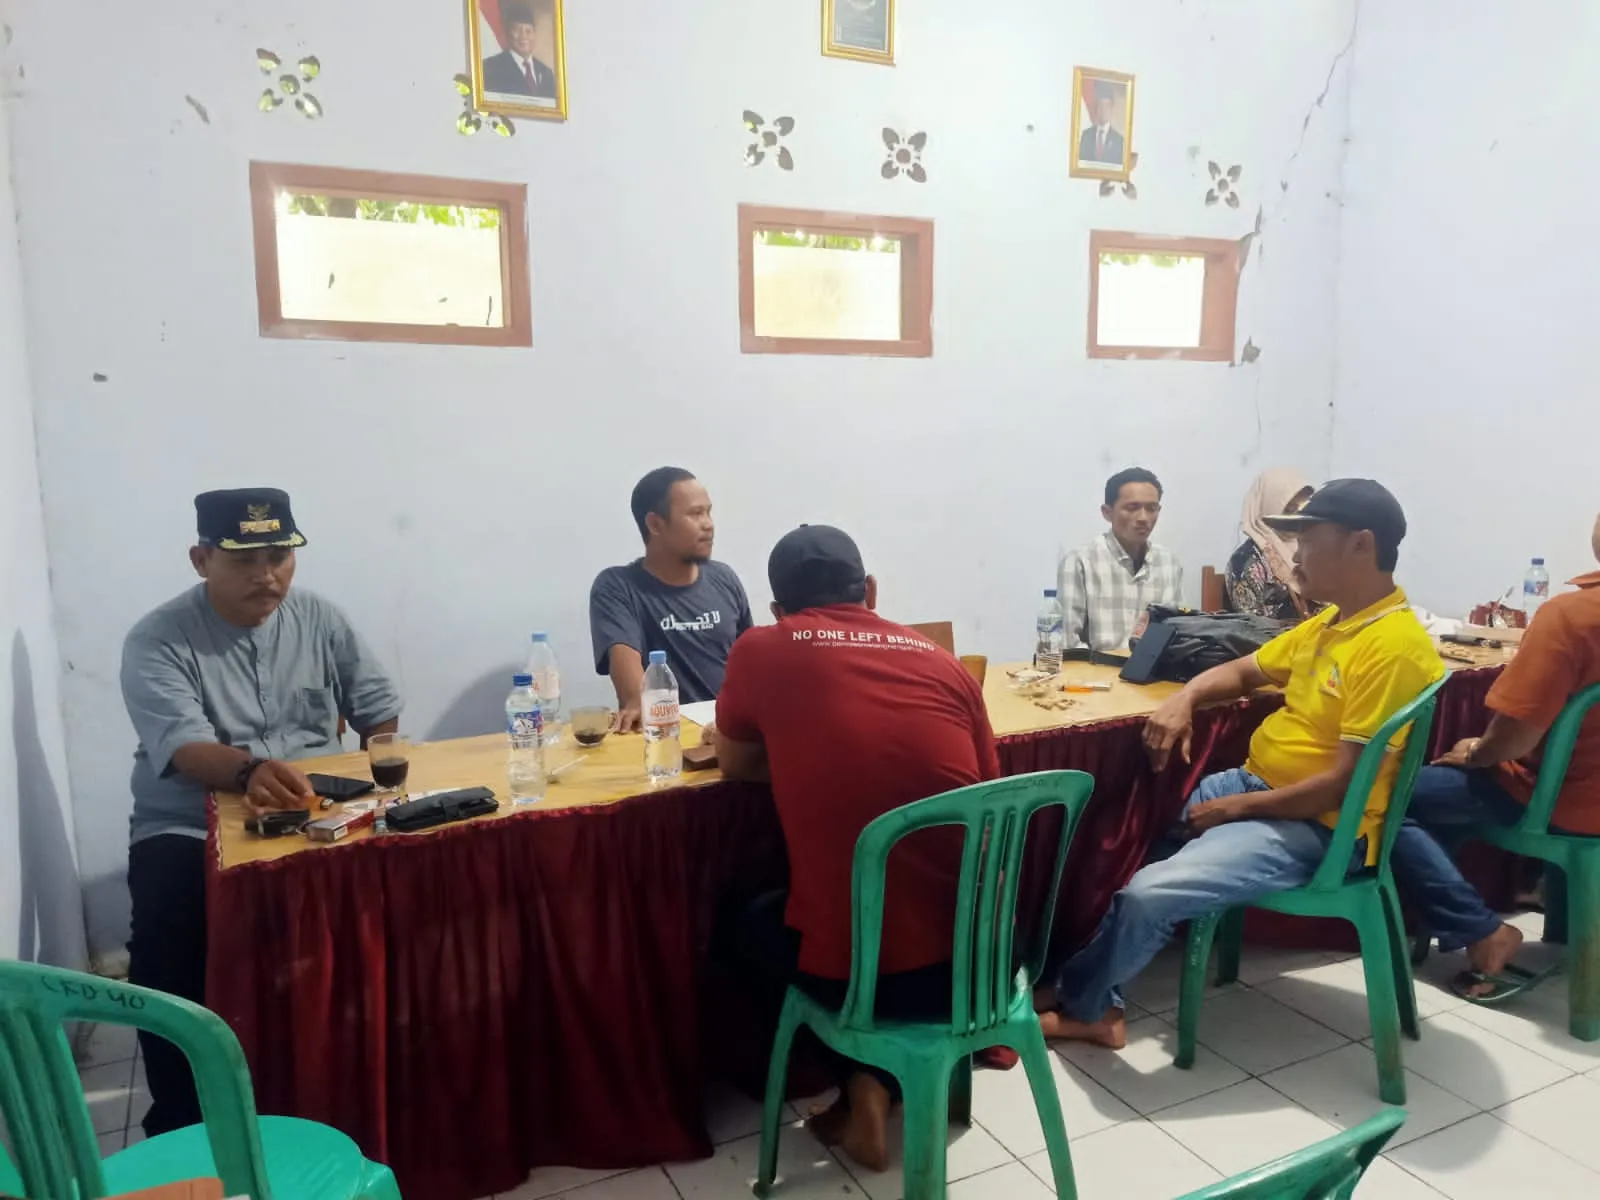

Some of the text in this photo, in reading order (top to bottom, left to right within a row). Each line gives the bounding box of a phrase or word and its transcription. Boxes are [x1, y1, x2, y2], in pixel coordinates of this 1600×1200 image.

[792, 629, 813, 641] NO
[817, 629, 846, 641] ONE
[850, 631, 883, 642] LEFT
